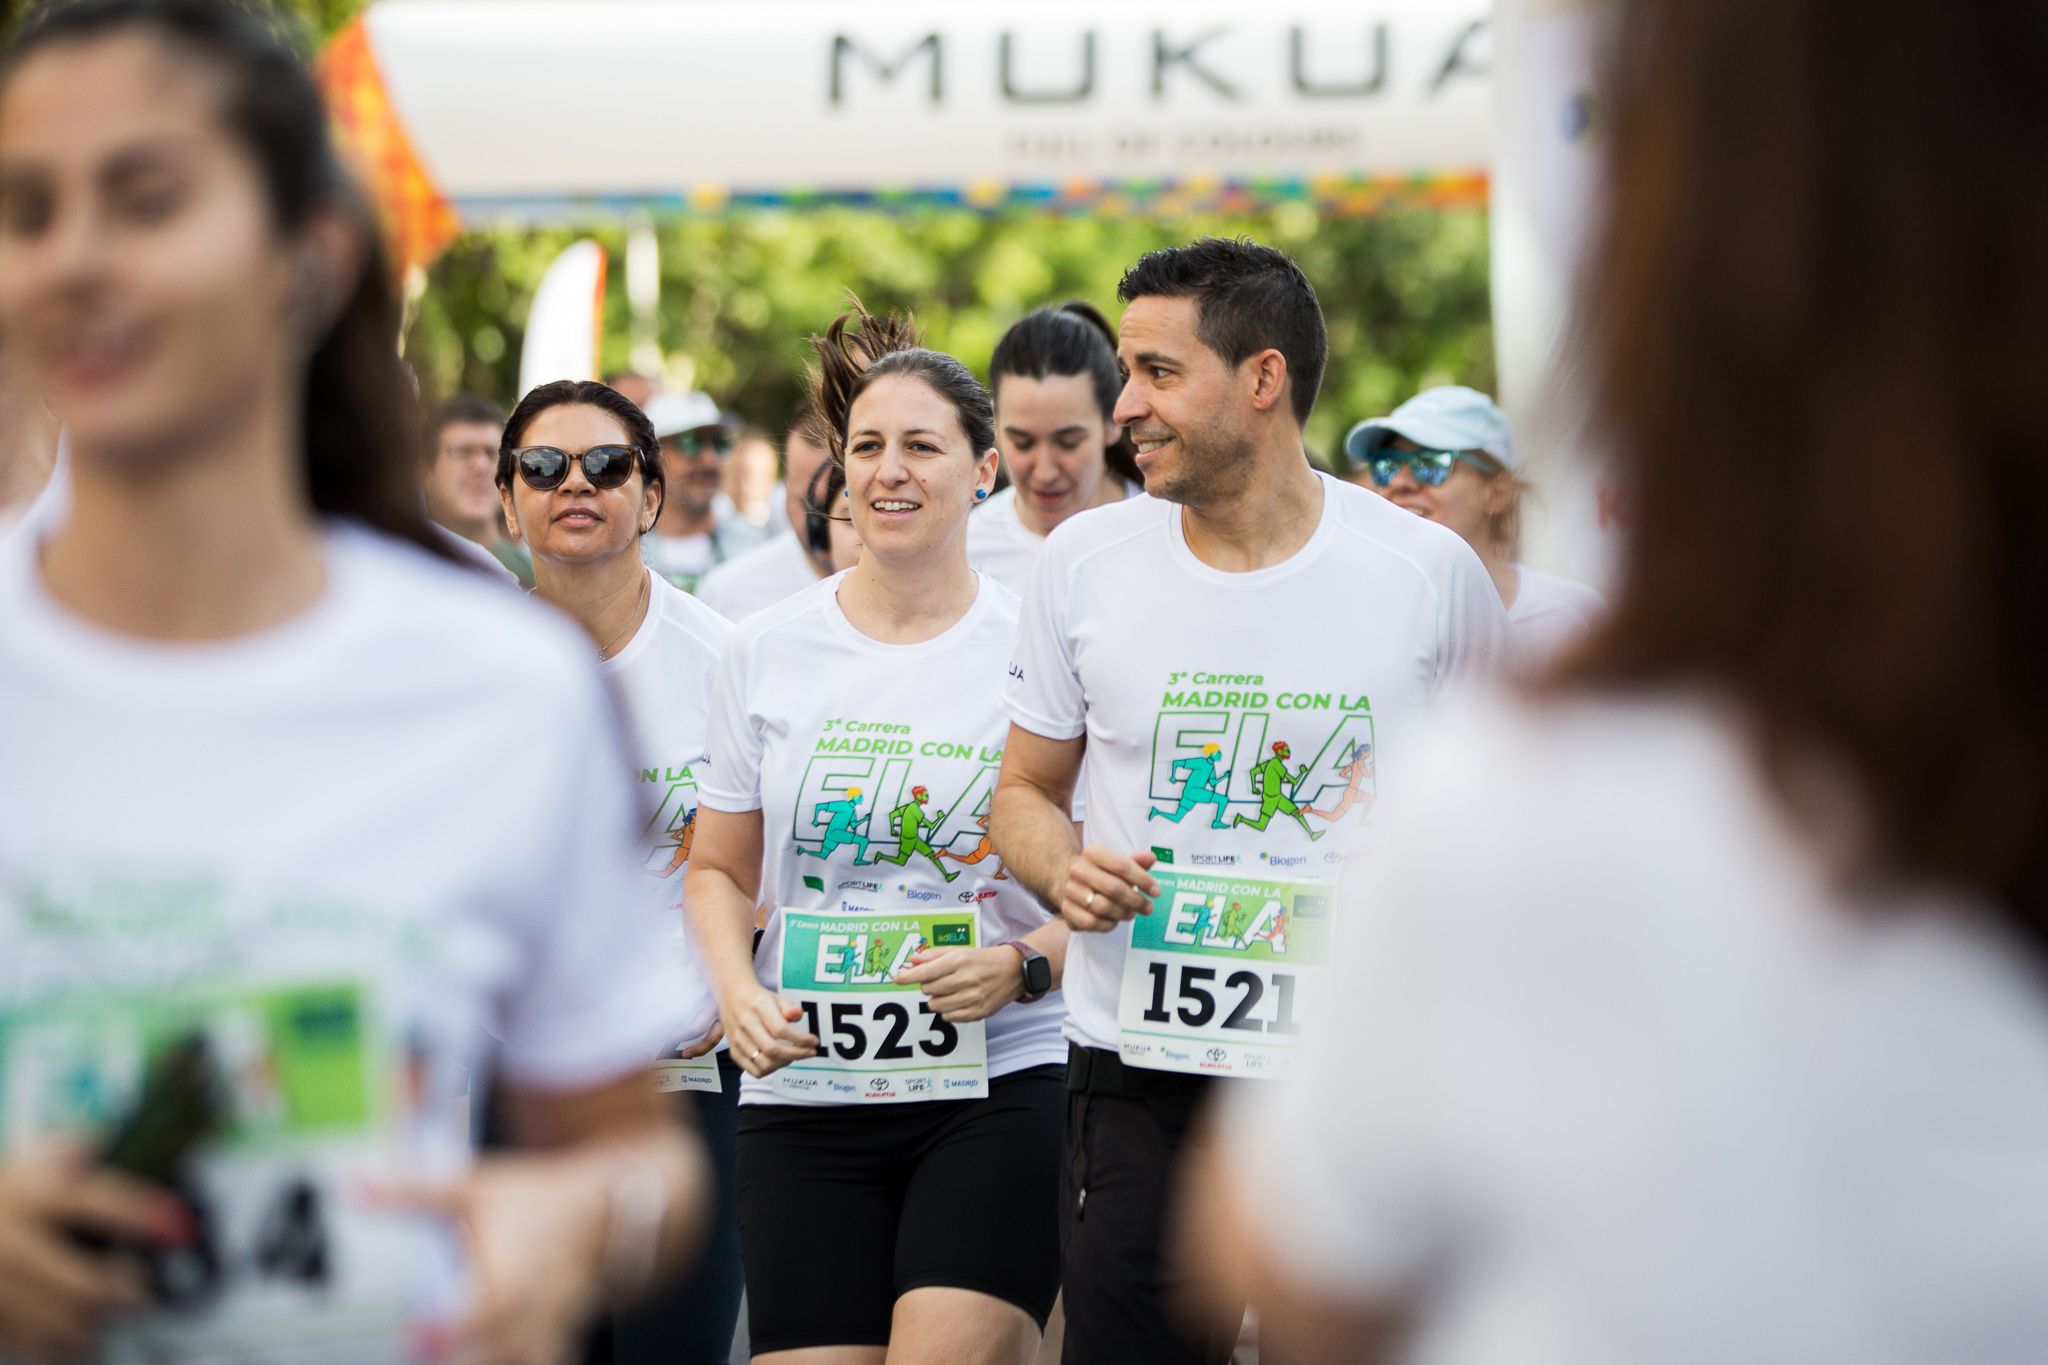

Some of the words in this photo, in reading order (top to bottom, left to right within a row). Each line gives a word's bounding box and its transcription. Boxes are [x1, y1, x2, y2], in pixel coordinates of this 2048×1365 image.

[825, 20, 1491, 107] MUKUA
[1192, 672, 1264, 686] Carrera
[1161, 691, 1269, 709] MADRID
[1276, 693, 1332, 710] CON
[1339, 694, 1371, 711] LA
[845, 720, 911, 734] Carrera
[815, 737, 913, 755] MADRID
[920, 742, 974, 760] CON
[664, 765, 693, 782] LA
[1269, 856, 1307, 867] Biogen
[907, 889, 942, 901] Biogen
[1178, 879, 1228, 893] MADRID
[1231, 884, 1261, 897] CON
[1264, 887, 1282, 898] LA
[820, 921, 869, 933] MADRID
[871, 920, 900, 932] CON
[903, 919, 921, 931] LA
[1163, 891, 1287, 954] ELA
[1143, 962, 1300, 1036] 1521
[800, 1001, 959, 1061] 1523
[783, 1077, 818, 1087] MUKUA
[951, 1079, 979, 1088] MADRID
